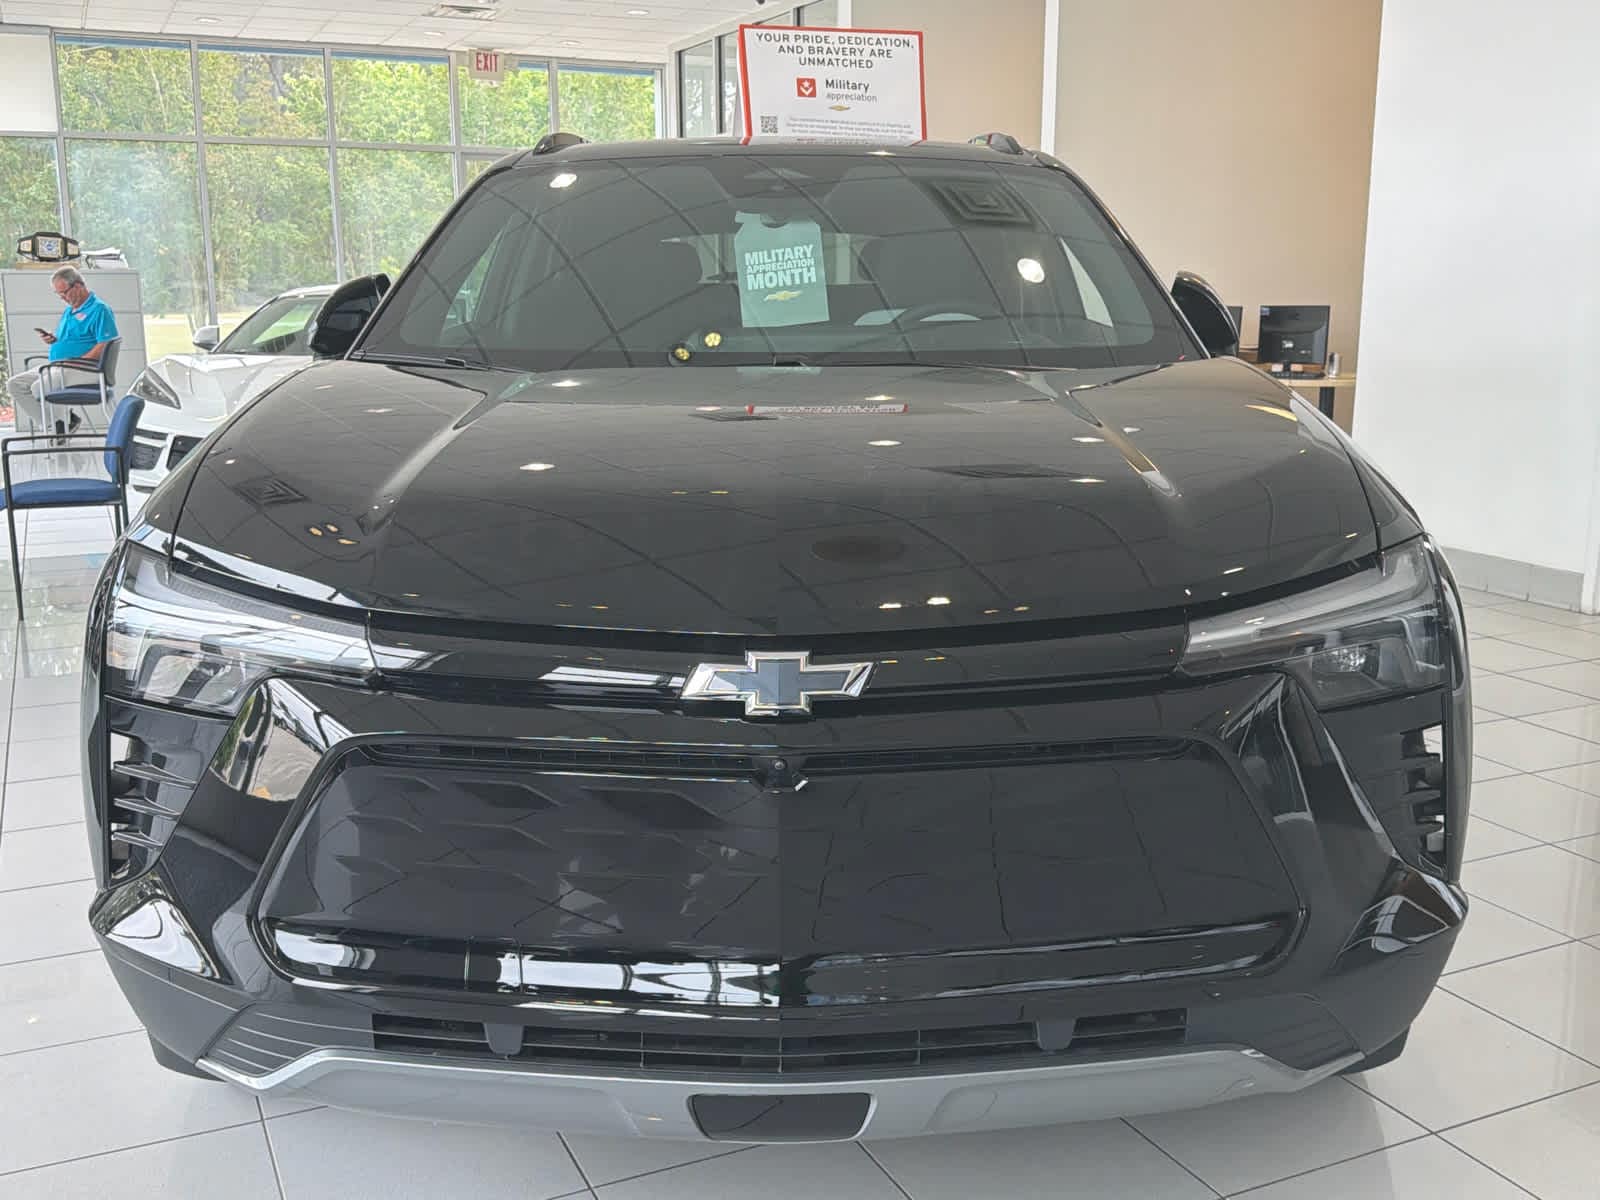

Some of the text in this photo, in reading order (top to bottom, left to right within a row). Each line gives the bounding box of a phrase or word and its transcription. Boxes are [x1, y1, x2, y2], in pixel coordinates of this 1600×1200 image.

[756, 33, 914, 49] YOUR PRIDE, DEDICATION,
[778, 45, 893, 58] AND BRAVERY ARE
[476, 52, 499, 72] EXIT
[799, 57, 873, 69] UNMATCHED
[825, 79, 870, 92] Military
[826, 92, 877, 102] appreciation
[744, 244, 814, 265] MILITARY
[746, 258, 814, 274] APPRECIATION
[747, 267, 817, 291] MONTH
